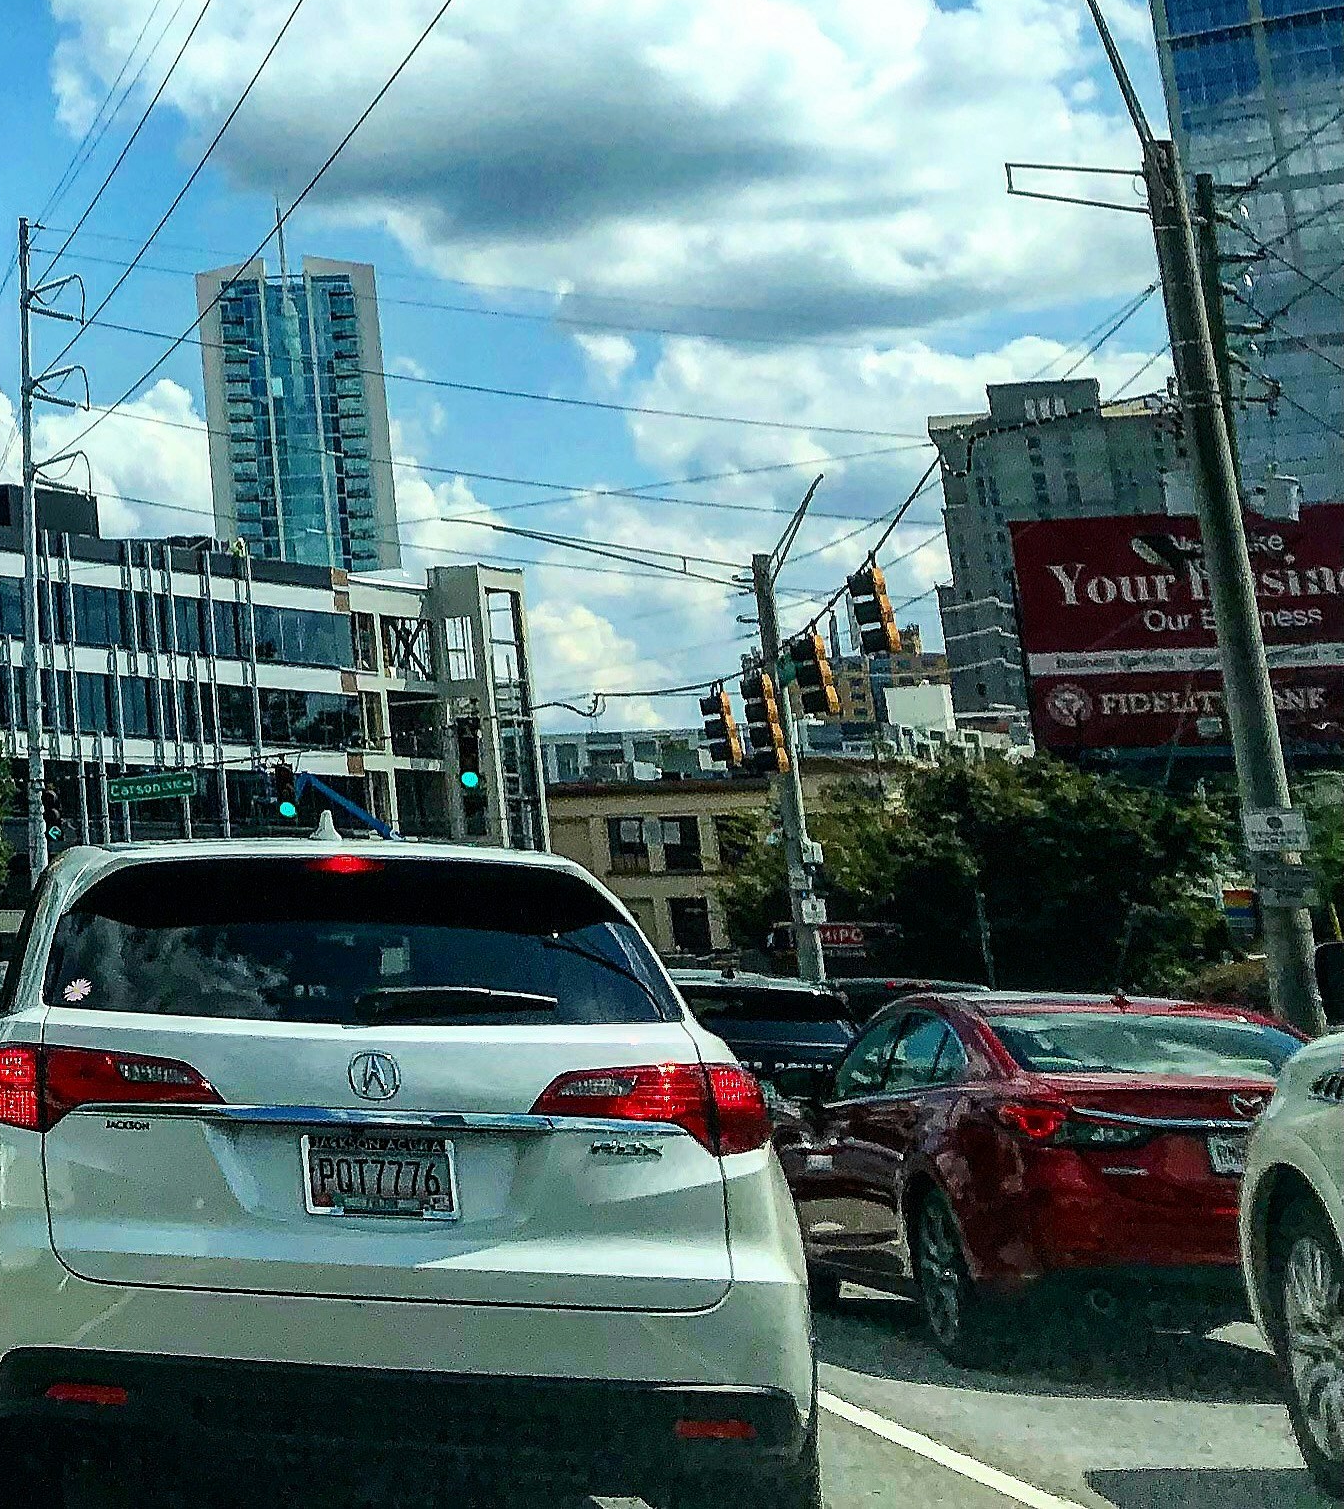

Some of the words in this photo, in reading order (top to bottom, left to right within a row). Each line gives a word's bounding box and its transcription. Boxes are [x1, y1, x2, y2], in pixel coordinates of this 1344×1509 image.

[1045, 562, 1176, 606] Your
[1143, 608, 1193, 633] Our
[1199, 605, 1323, 630] Bness
[1100, 690, 1222, 714] FIDELIT
[110, 782, 161, 797] Carson
[105, 1120, 150, 1131] JACKSON
[318, 1156, 442, 1197] PQT7776
